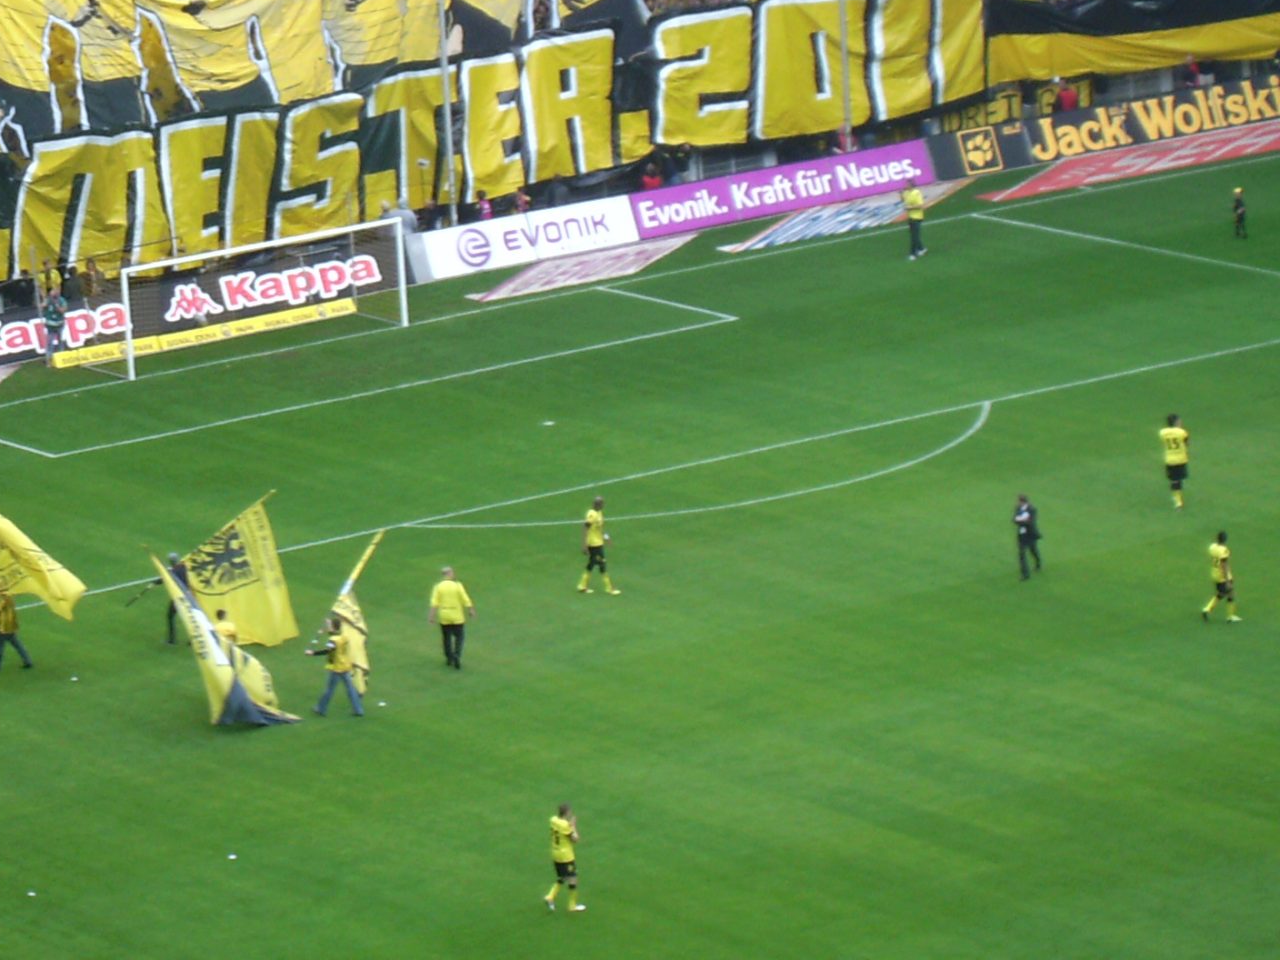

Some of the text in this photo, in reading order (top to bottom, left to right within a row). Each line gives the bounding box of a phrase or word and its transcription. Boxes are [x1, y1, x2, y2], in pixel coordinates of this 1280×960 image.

[12, 28, 616, 280] MEISTER
[1032, 106, 1133, 161] Jack
[638, 189, 728, 229] Evonik.
[730, 175, 795, 211] Kraft
[795, 170, 832, 198] für
[835, 158, 922, 191] Neues.
[503, 213, 610, 251] EVONIK
[221, 256, 381, 310] Kappa
